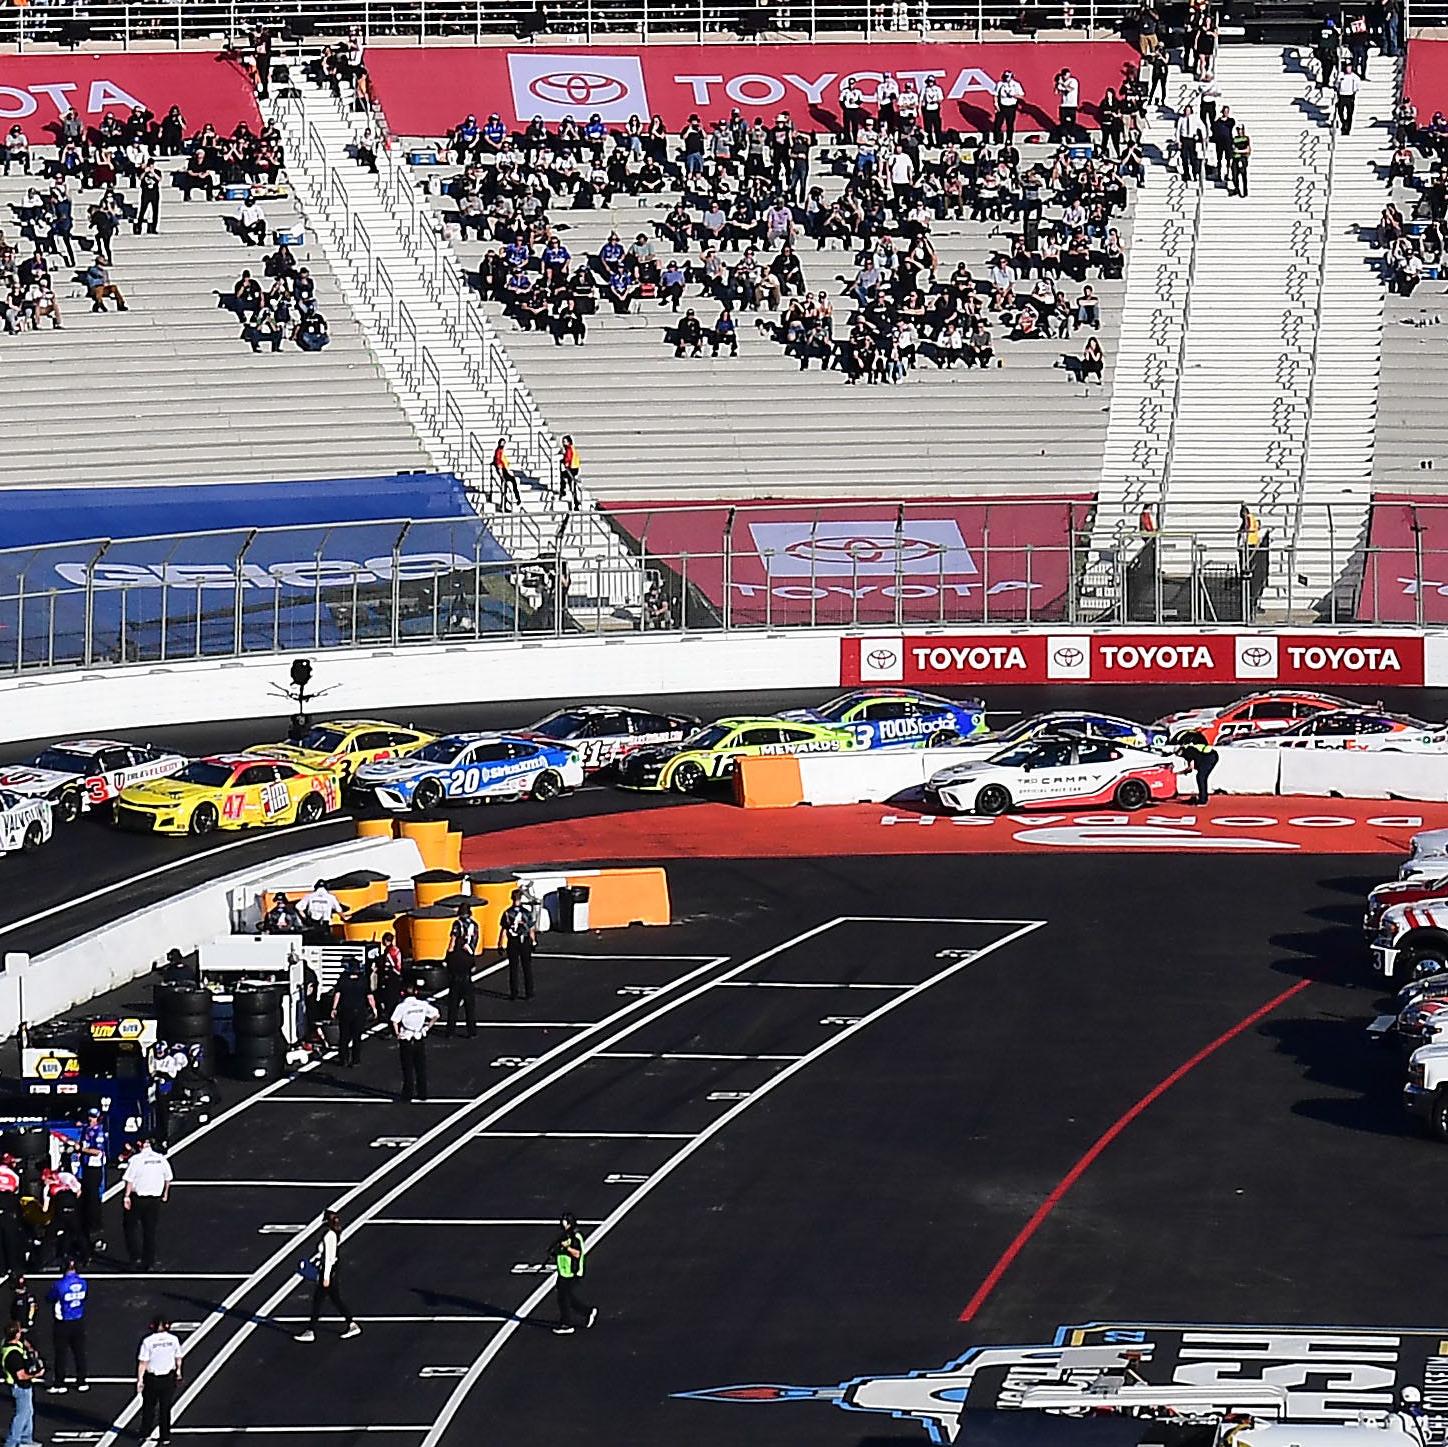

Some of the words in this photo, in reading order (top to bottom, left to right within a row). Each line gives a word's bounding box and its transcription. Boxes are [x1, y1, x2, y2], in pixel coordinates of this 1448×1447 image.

[675, 67, 998, 105] TOYOTA
[55, 553, 471, 588] GEICO
[729, 578, 1044, 599] TOYOTA
[912, 646, 1027, 671] TOYOTA
[1099, 645, 1214, 670] TOYOTA
[1288, 646, 1401, 671] TOYOTA
[761, 739, 840, 755] MENARDS
[1314, 739, 1369, 751] FedEx
[85, 776, 109, 803] 3
[449, 768, 480, 795] 20
[1042, 775, 1101, 784] CAMRY
[223, 794, 245, 820] 47
[881, 815, 1423, 826] DOORDASH
